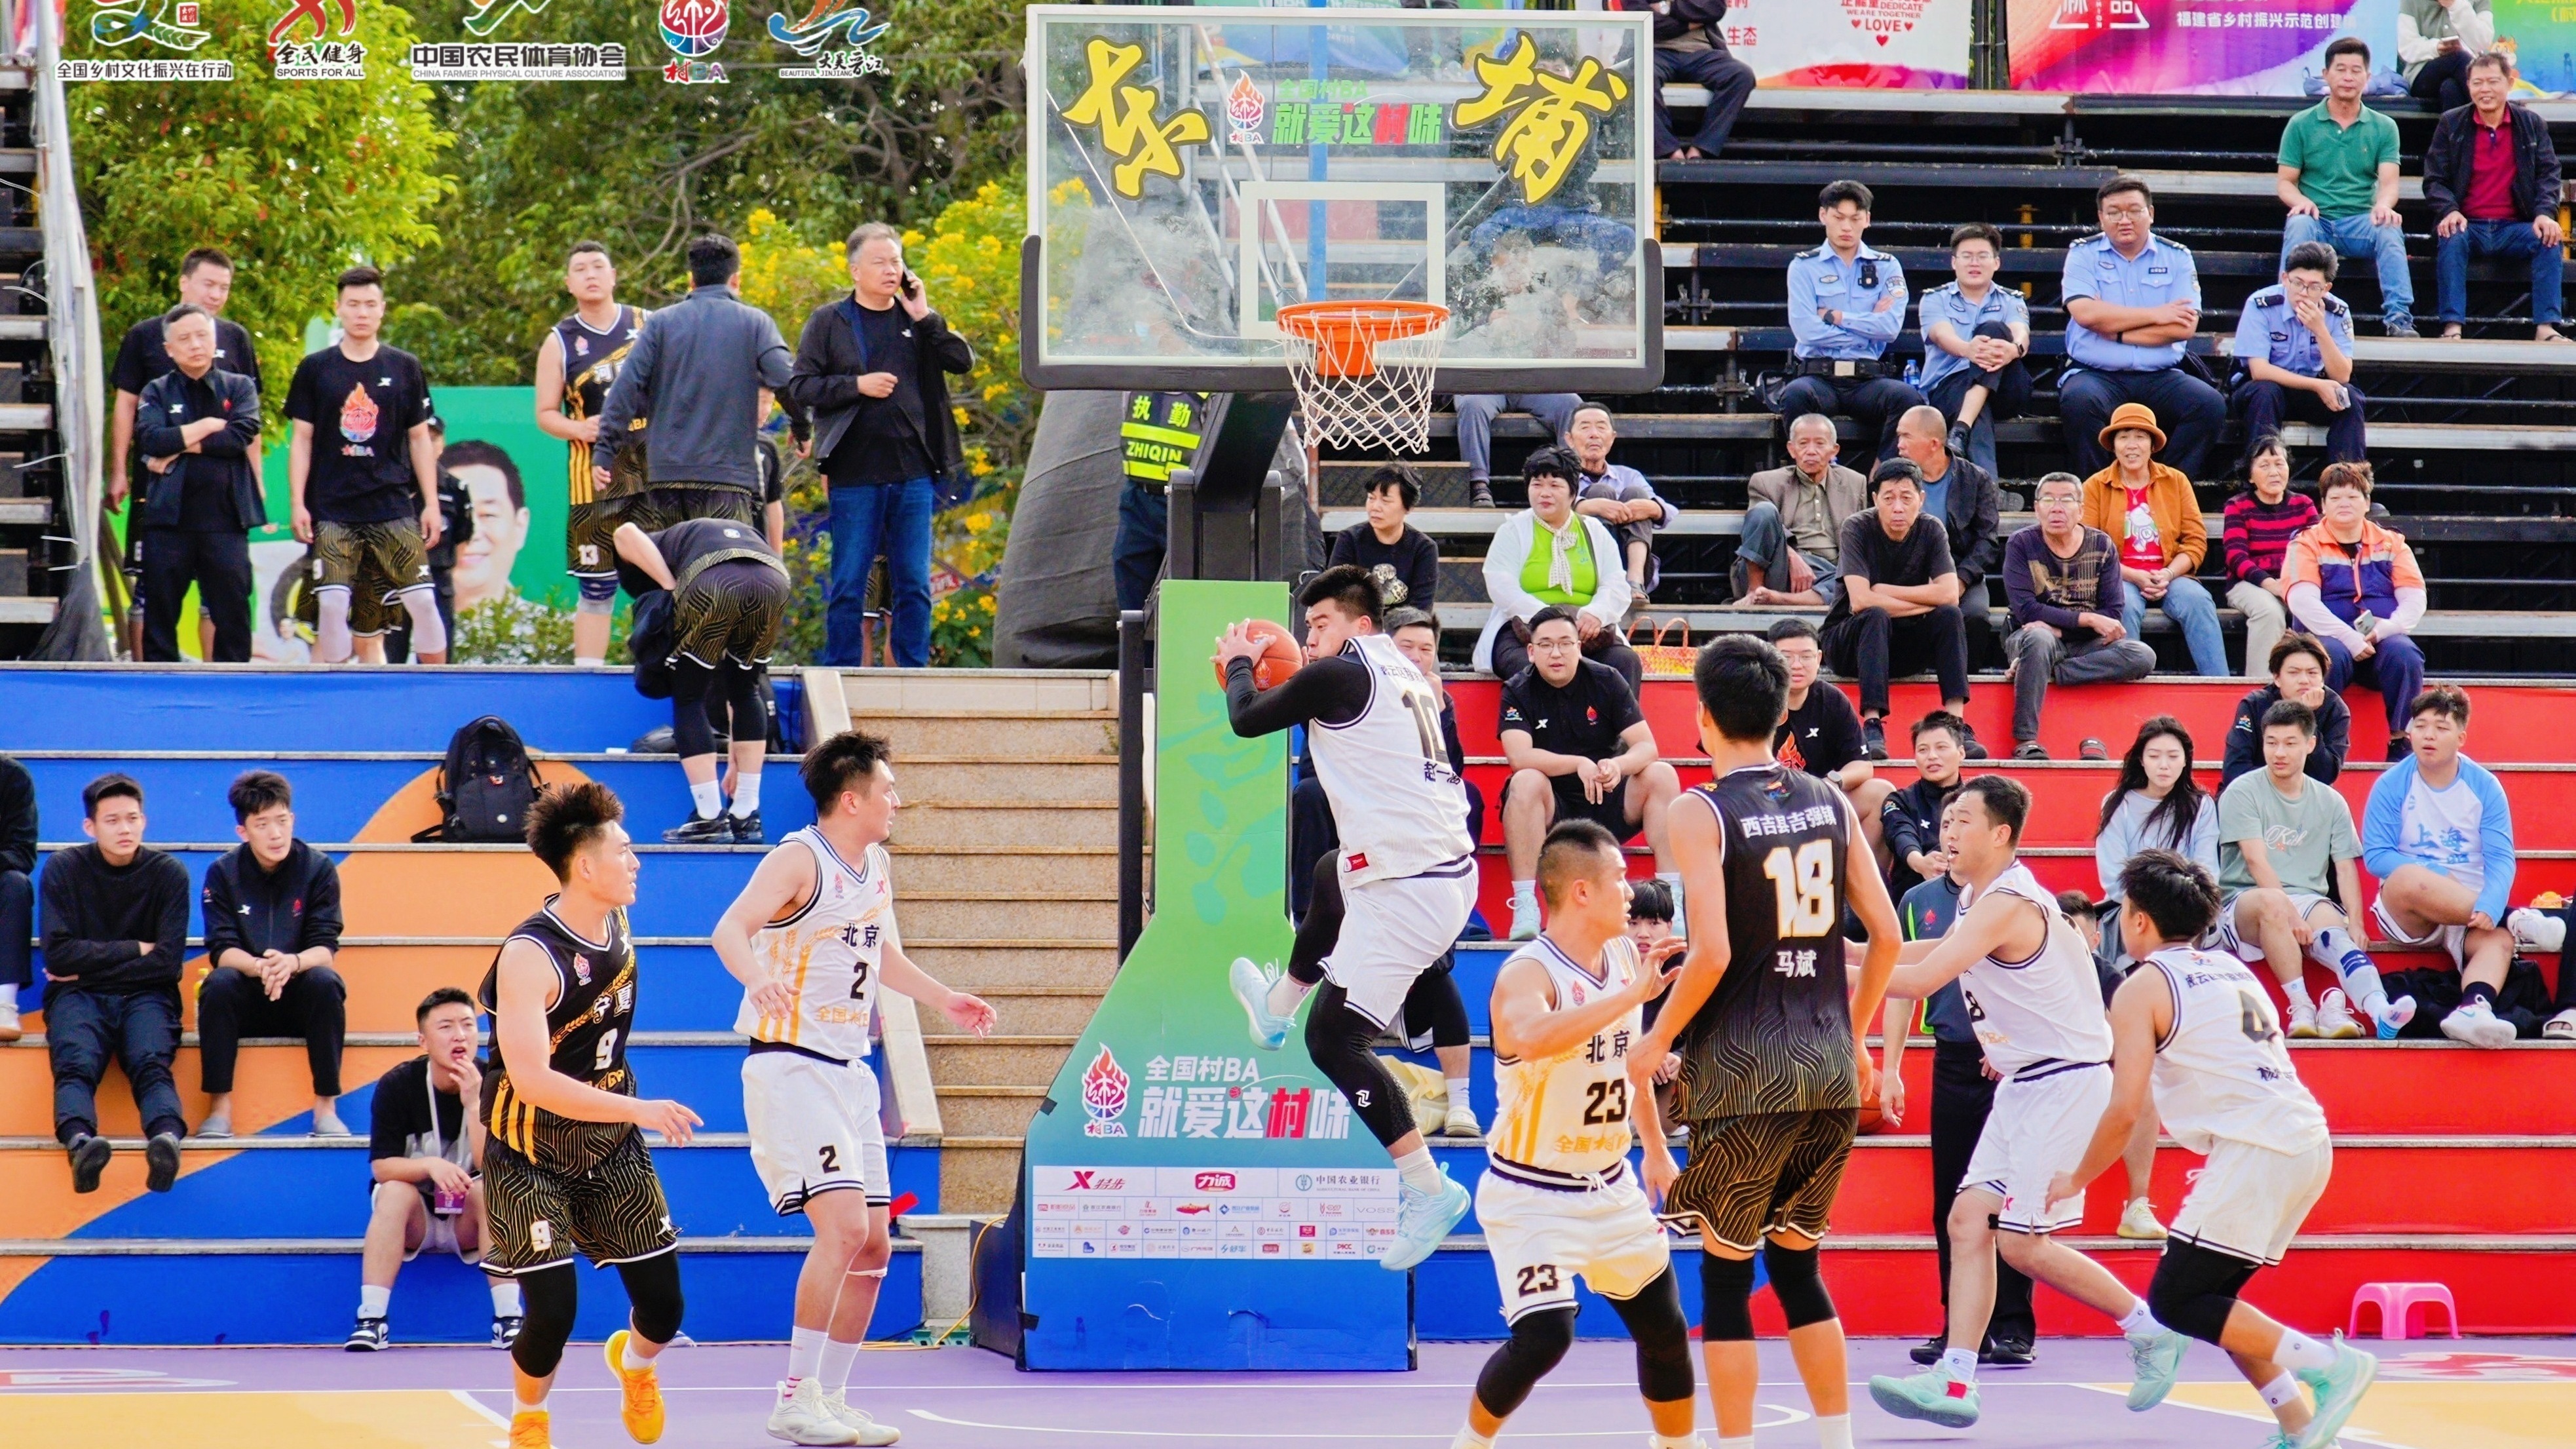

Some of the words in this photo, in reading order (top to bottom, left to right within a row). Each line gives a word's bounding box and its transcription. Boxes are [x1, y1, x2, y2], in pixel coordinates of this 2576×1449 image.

[1881, 2, 1923, 12] DEDICATE
[2176, 11, 2357, 29] 福建省乡村振兴示范创建
[1866, 18, 1900, 32] LOVE
[1278, 78, 1369, 99] 全国村BA
[1272, 103, 1443, 144] 就爱这村味
[1132, 395, 1192, 428] 执勤
[1126, 440, 1183, 463] ZHIQIN
[578, 544, 599, 566] 13
[1401, 689, 1451, 765] 10
[1740, 805, 1837, 840] 西吉县吉强镇
[2409, 822, 2469, 853] 上海
[1763, 838, 1835, 941] 18
[842, 922, 880, 949] 北京
[1774, 949, 1818, 978] 马斌
[850, 961, 869, 1000] 2
[592, 980, 634, 1024] 宁夏
[2237, 989, 2278, 1043] 4
[594, 1028, 618, 1071] 9
[1585, 1029, 1631, 1066] 北京
[1145, 1054, 1261, 1083] 全国村BA
[1137, 1086, 1352, 1140] 就爱这村味
[1583, 1078, 1627, 1126] 23
[820, 1144, 842, 1175] 2
[1198, 1174, 1233, 1189] 力诚
[1316, 1174, 1380, 1186] 中国农业银行
[531, 1220, 552, 1252] 9
[1517, 1264, 1559, 1298] 23
